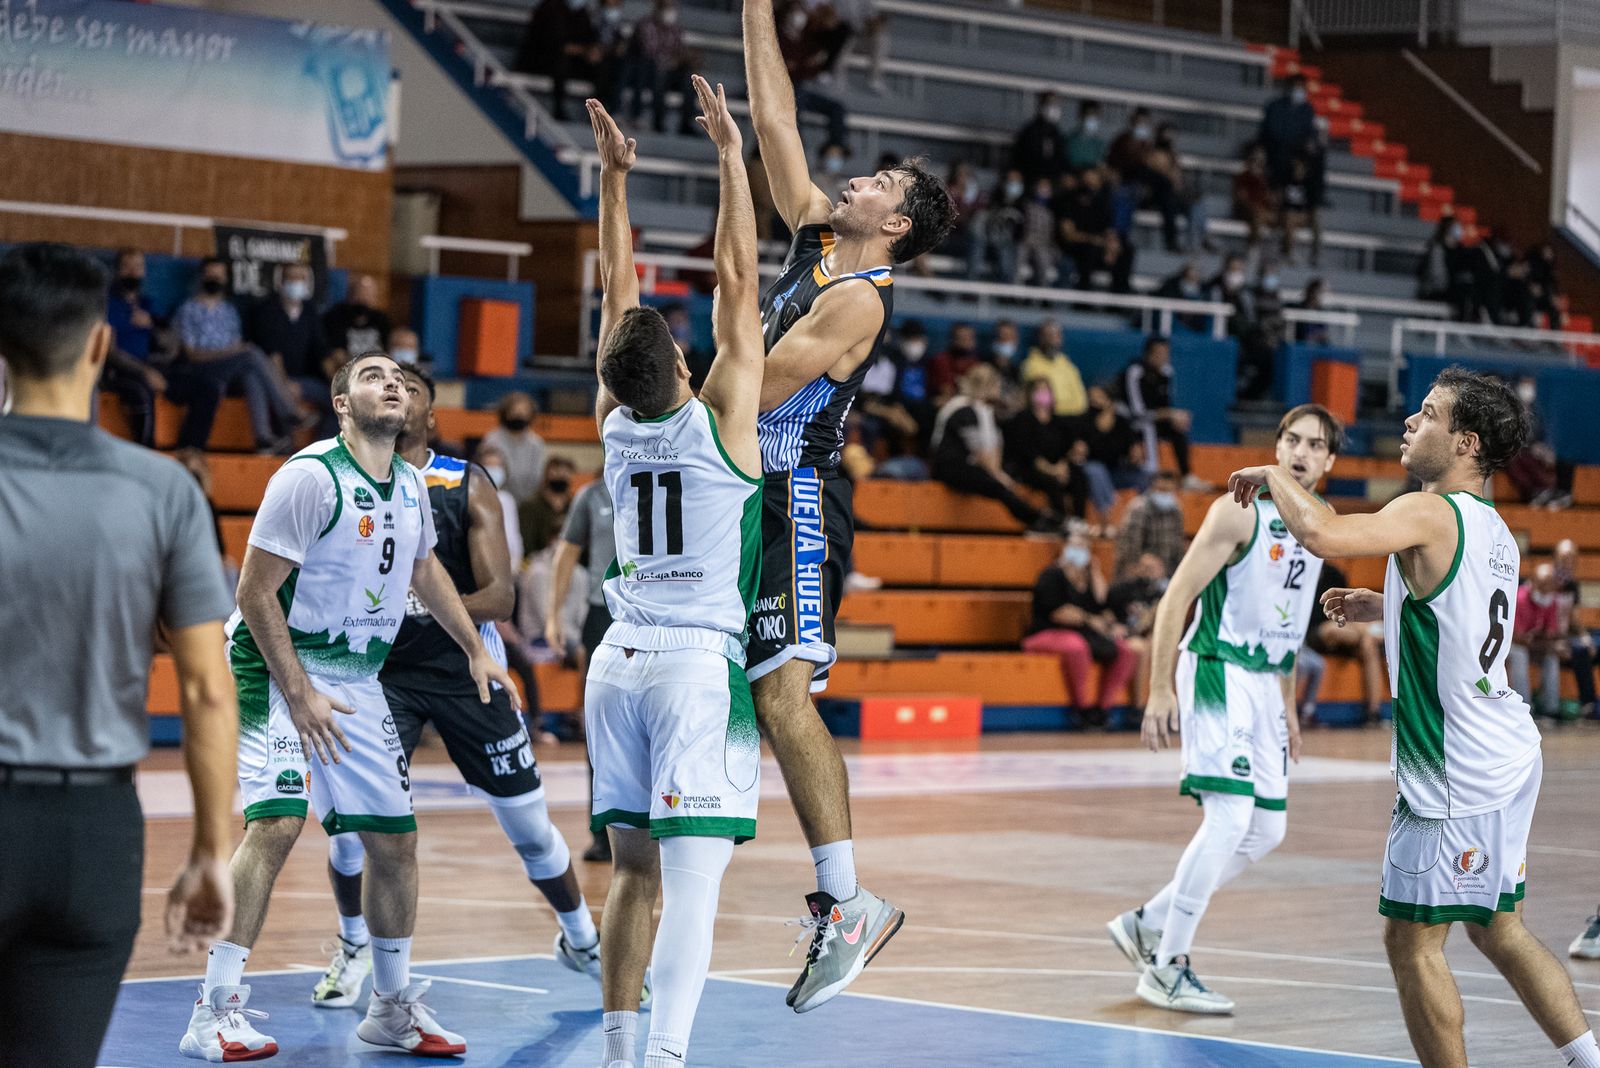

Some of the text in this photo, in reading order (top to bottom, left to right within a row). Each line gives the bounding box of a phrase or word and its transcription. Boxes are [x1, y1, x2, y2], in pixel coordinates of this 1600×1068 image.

[630, 471, 683, 555] 11
[378, 537, 395, 575] 9
[671, 570, 703, 578] Banco
[1283, 560, 1306, 590] 12
[342, 616, 397, 627] Extremadura
[796, 563, 823, 645] HUELV
[756, 614, 786, 641] ORO
[1478, 588, 1509, 674] 6
[396, 755, 410, 792] 9
